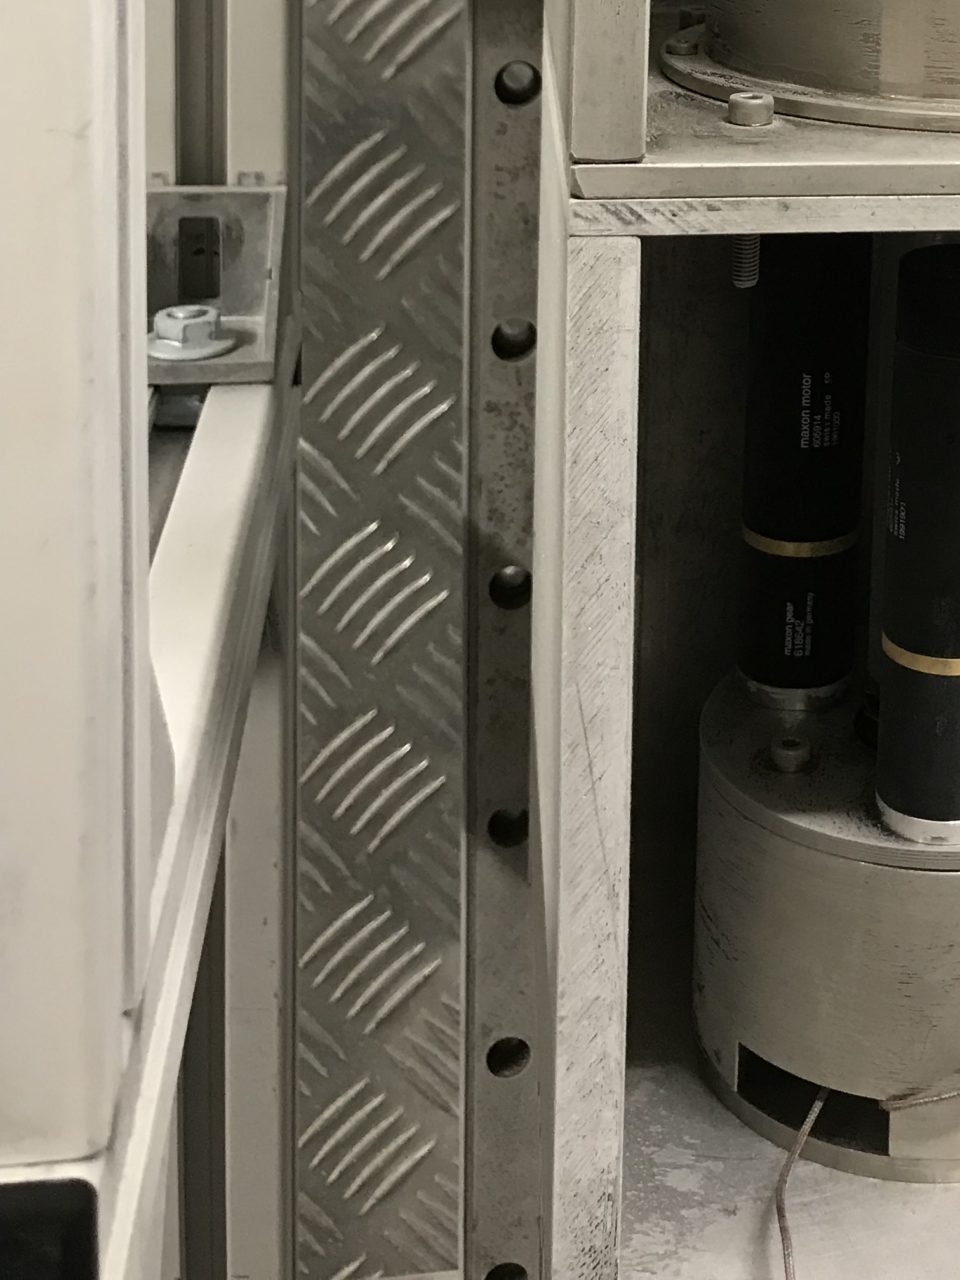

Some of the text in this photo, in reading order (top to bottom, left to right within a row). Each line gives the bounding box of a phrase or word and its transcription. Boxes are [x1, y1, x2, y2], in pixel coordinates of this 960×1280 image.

[800, 373, 812, 449] maxon motor
[784, 624, 793, 656] maxon
